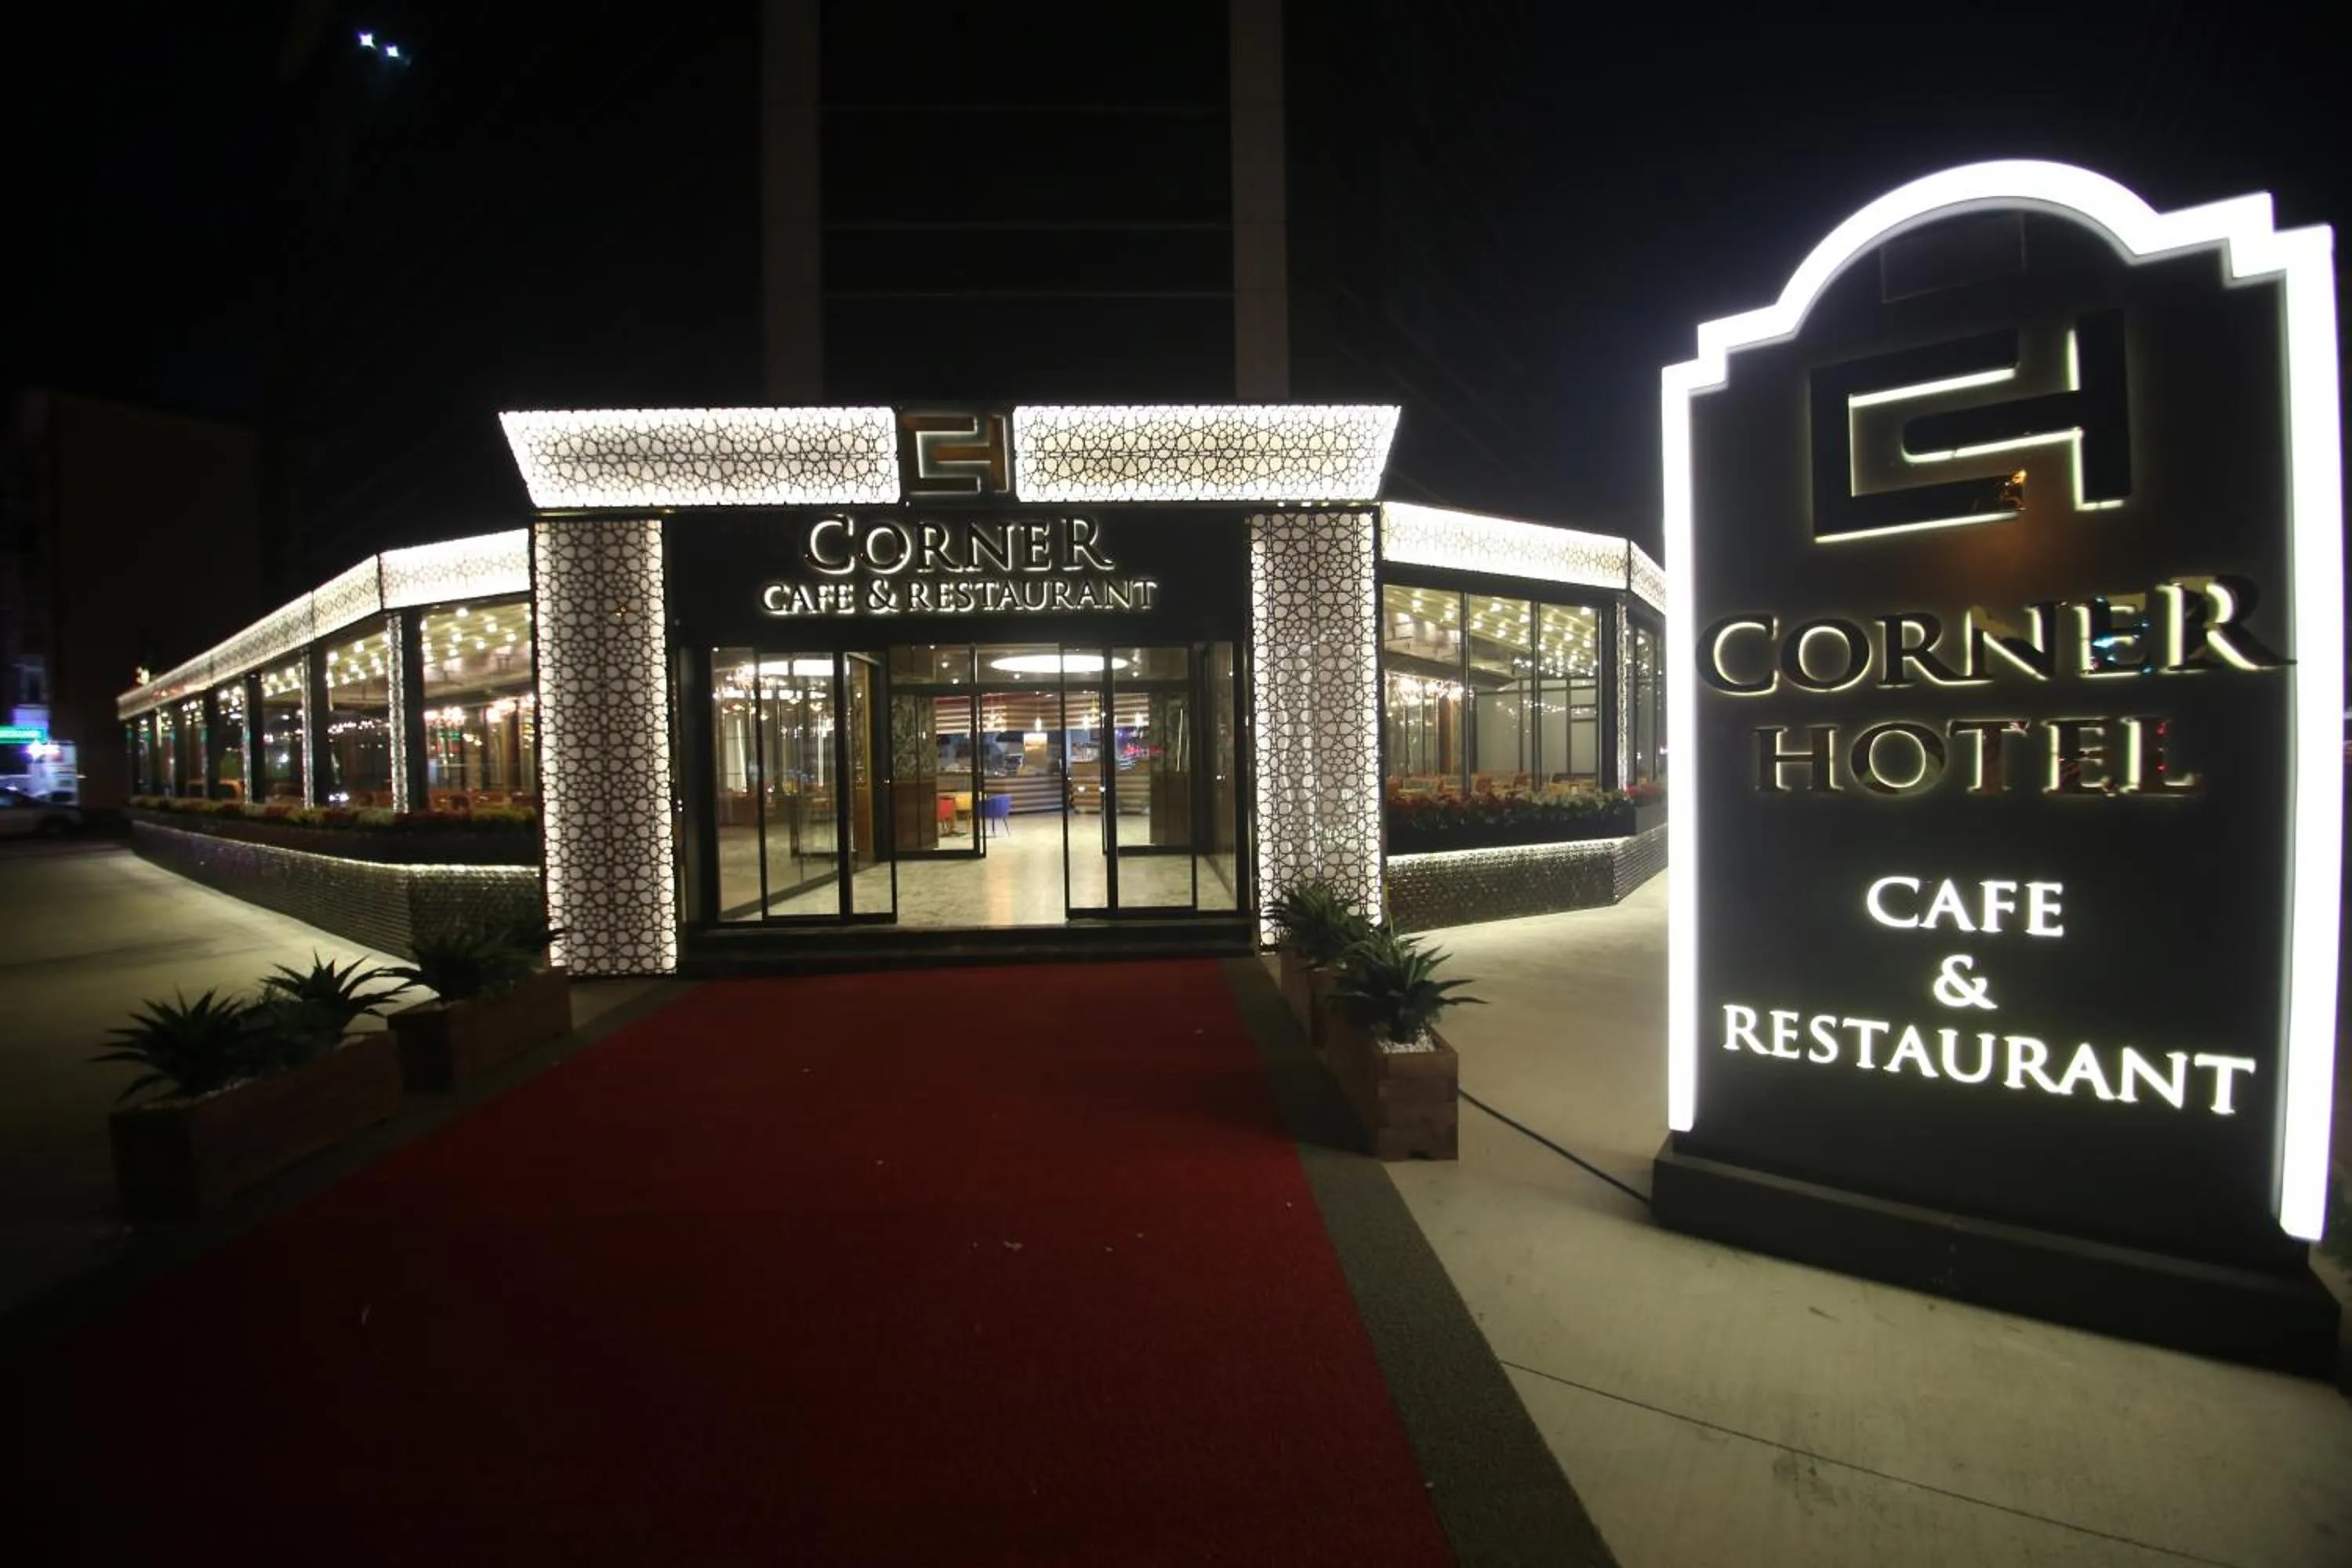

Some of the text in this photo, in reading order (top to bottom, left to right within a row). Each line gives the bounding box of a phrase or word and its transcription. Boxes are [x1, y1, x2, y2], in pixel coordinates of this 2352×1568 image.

[804, 513, 1116, 575] CORNER
[760, 578, 1158, 615] CAFE & RESTAURANT
[1695, 573, 2298, 696] CORNER
[1751, 715, 2205, 797] HOTEL
[1865, 875, 2065, 938] CAFE
[1932, 953, 1998, 1010] &
[1722, 1004, 2256, 1116] RESTAURANT
